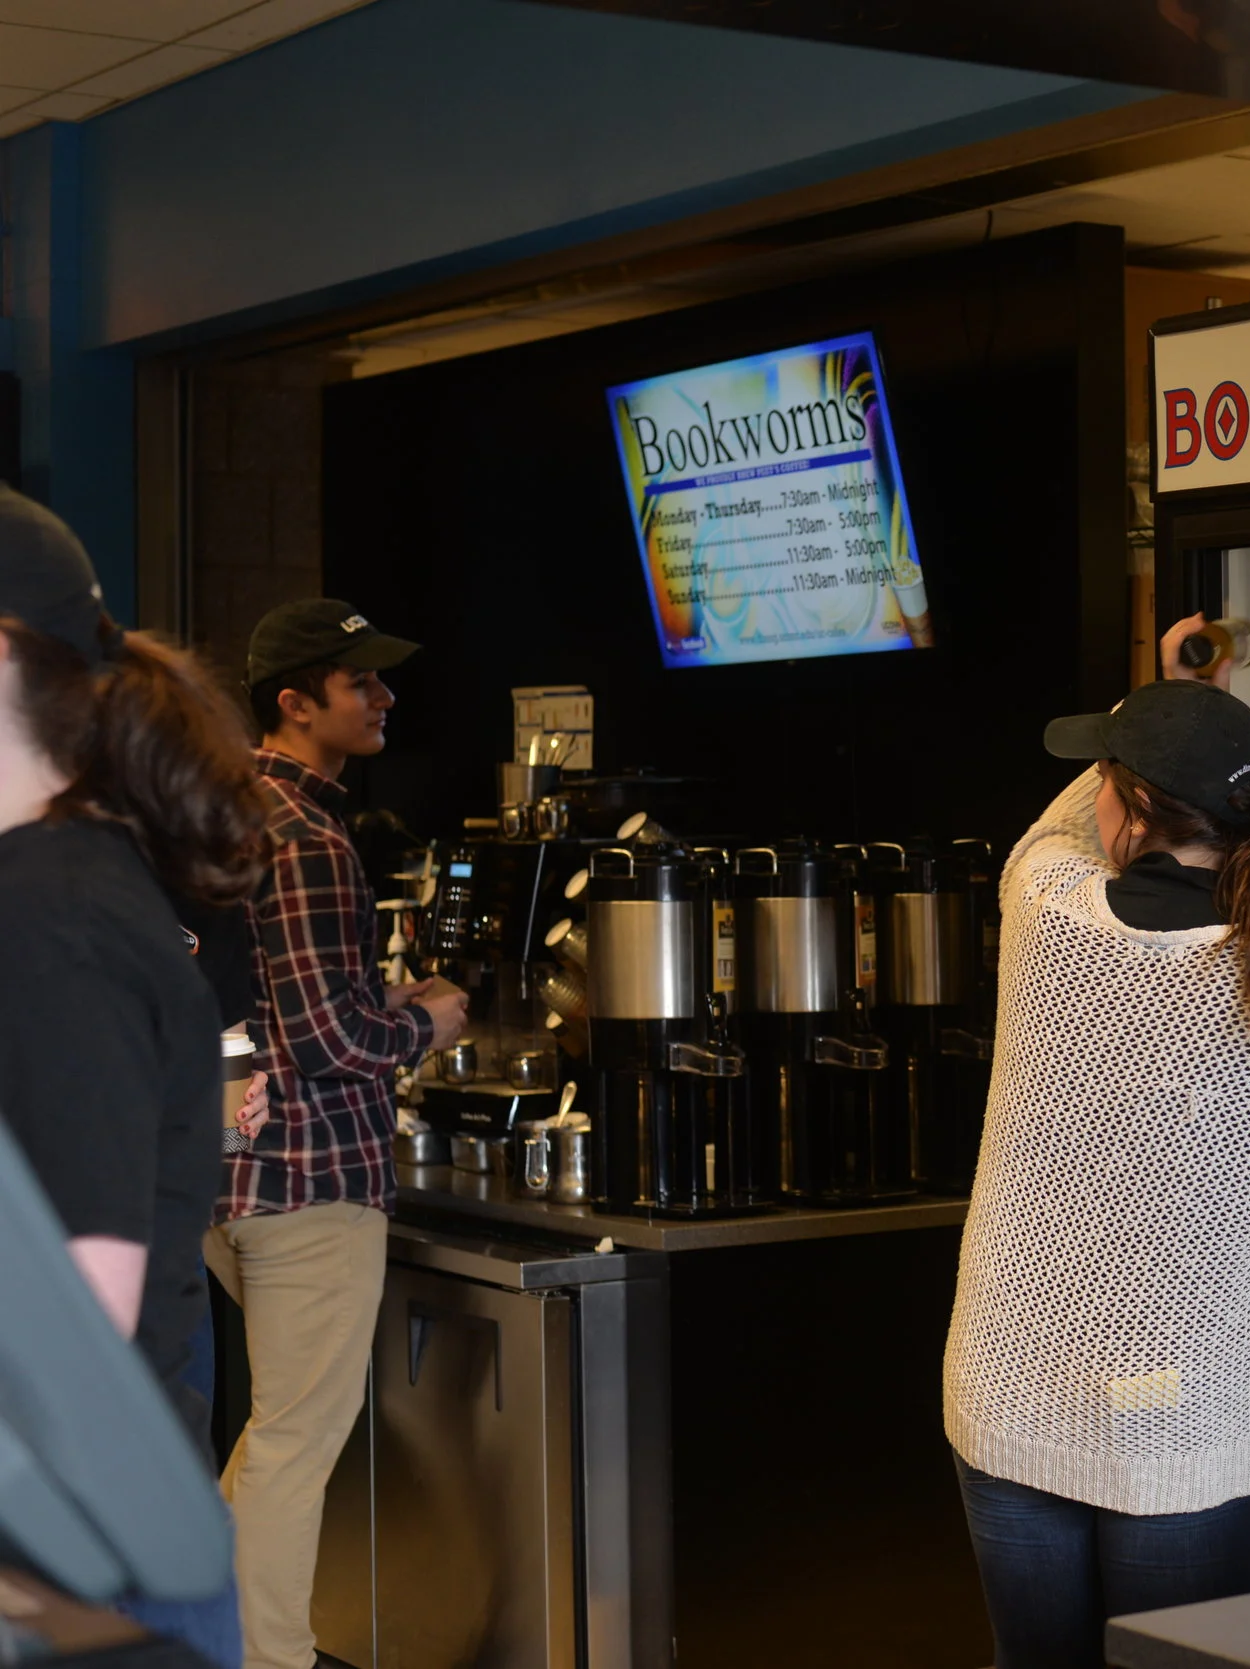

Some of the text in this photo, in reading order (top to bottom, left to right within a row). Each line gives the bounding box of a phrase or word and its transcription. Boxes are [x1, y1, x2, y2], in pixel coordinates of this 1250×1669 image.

[633, 394, 867, 477] Bookworms
[652, 506, 697, 528] Monday
[705, 498, 761, 520] Thursday
[780, 489, 821, 510] 7:30am
[827, 481, 879, 503] Midnight
[656, 536, 692, 556] Friday
[786, 517, 827, 536] 7:30am
[838, 509, 881, 531] 5:00pm
[662, 560, 708, 580] Saturday
[787, 546, 832, 564] 11:30am
[844, 539, 887, 559] 5:00pm
[668, 587, 707, 607] Sunday
[792, 572, 838, 591] 11:30am
[845, 565, 898, 587] Midnight
